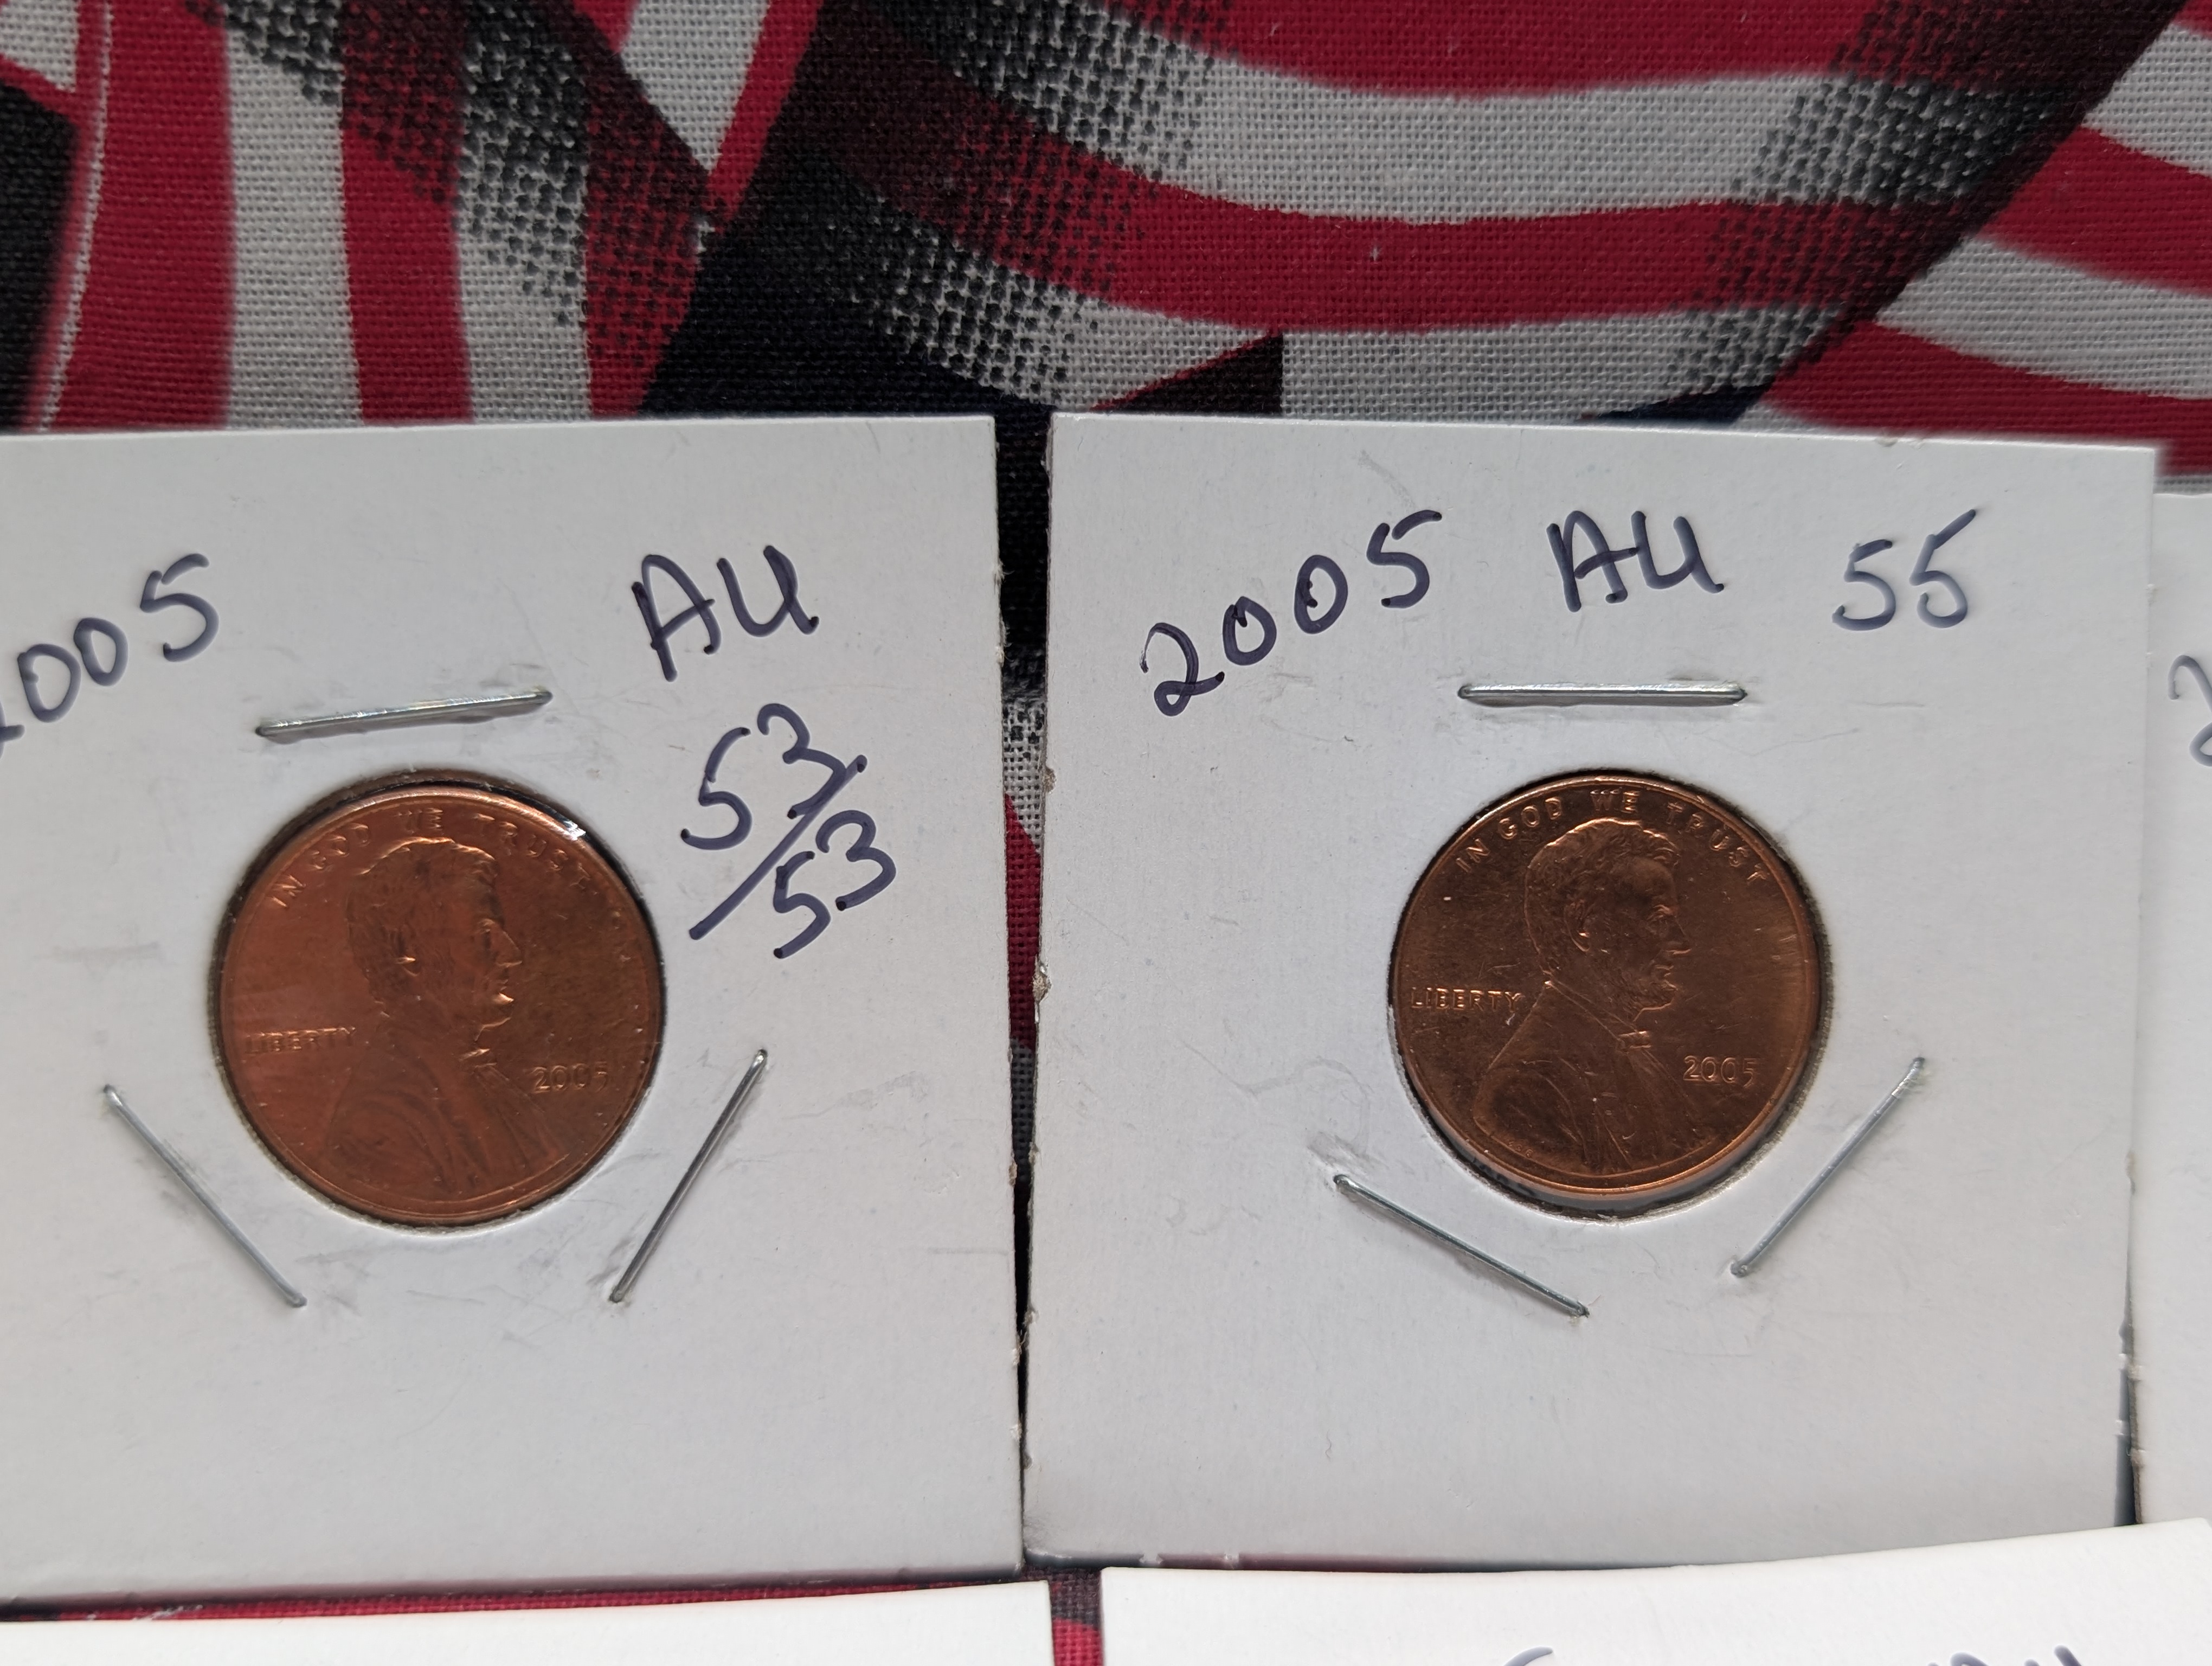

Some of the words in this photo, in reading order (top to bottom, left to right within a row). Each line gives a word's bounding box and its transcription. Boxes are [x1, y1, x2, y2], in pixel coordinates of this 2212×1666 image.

[632, 545, 819, 682] AU
[1140, 509, 1442, 716] 2005
[1546, 510, 1725, 612] AU
[1832, 508, 1977, 631] 55
[271, 874, 307, 909] IN
[309, 822, 372, 871] GOD
[396, 807, 443, 834] WE
[1455, 838, 1490, 873] IN
[1497, 796, 1562, 840] GOD
[1590, 789, 1640, 813] WE
[1666, 802, 1770, 885] TRUST
[1411, 986, 1526, 1013] LIBERTY
[245, 1027, 357, 1054] LIBERTY
[1683, 1055, 1760, 1089] 2005
[529, 1061, 609, 1094] 2005
